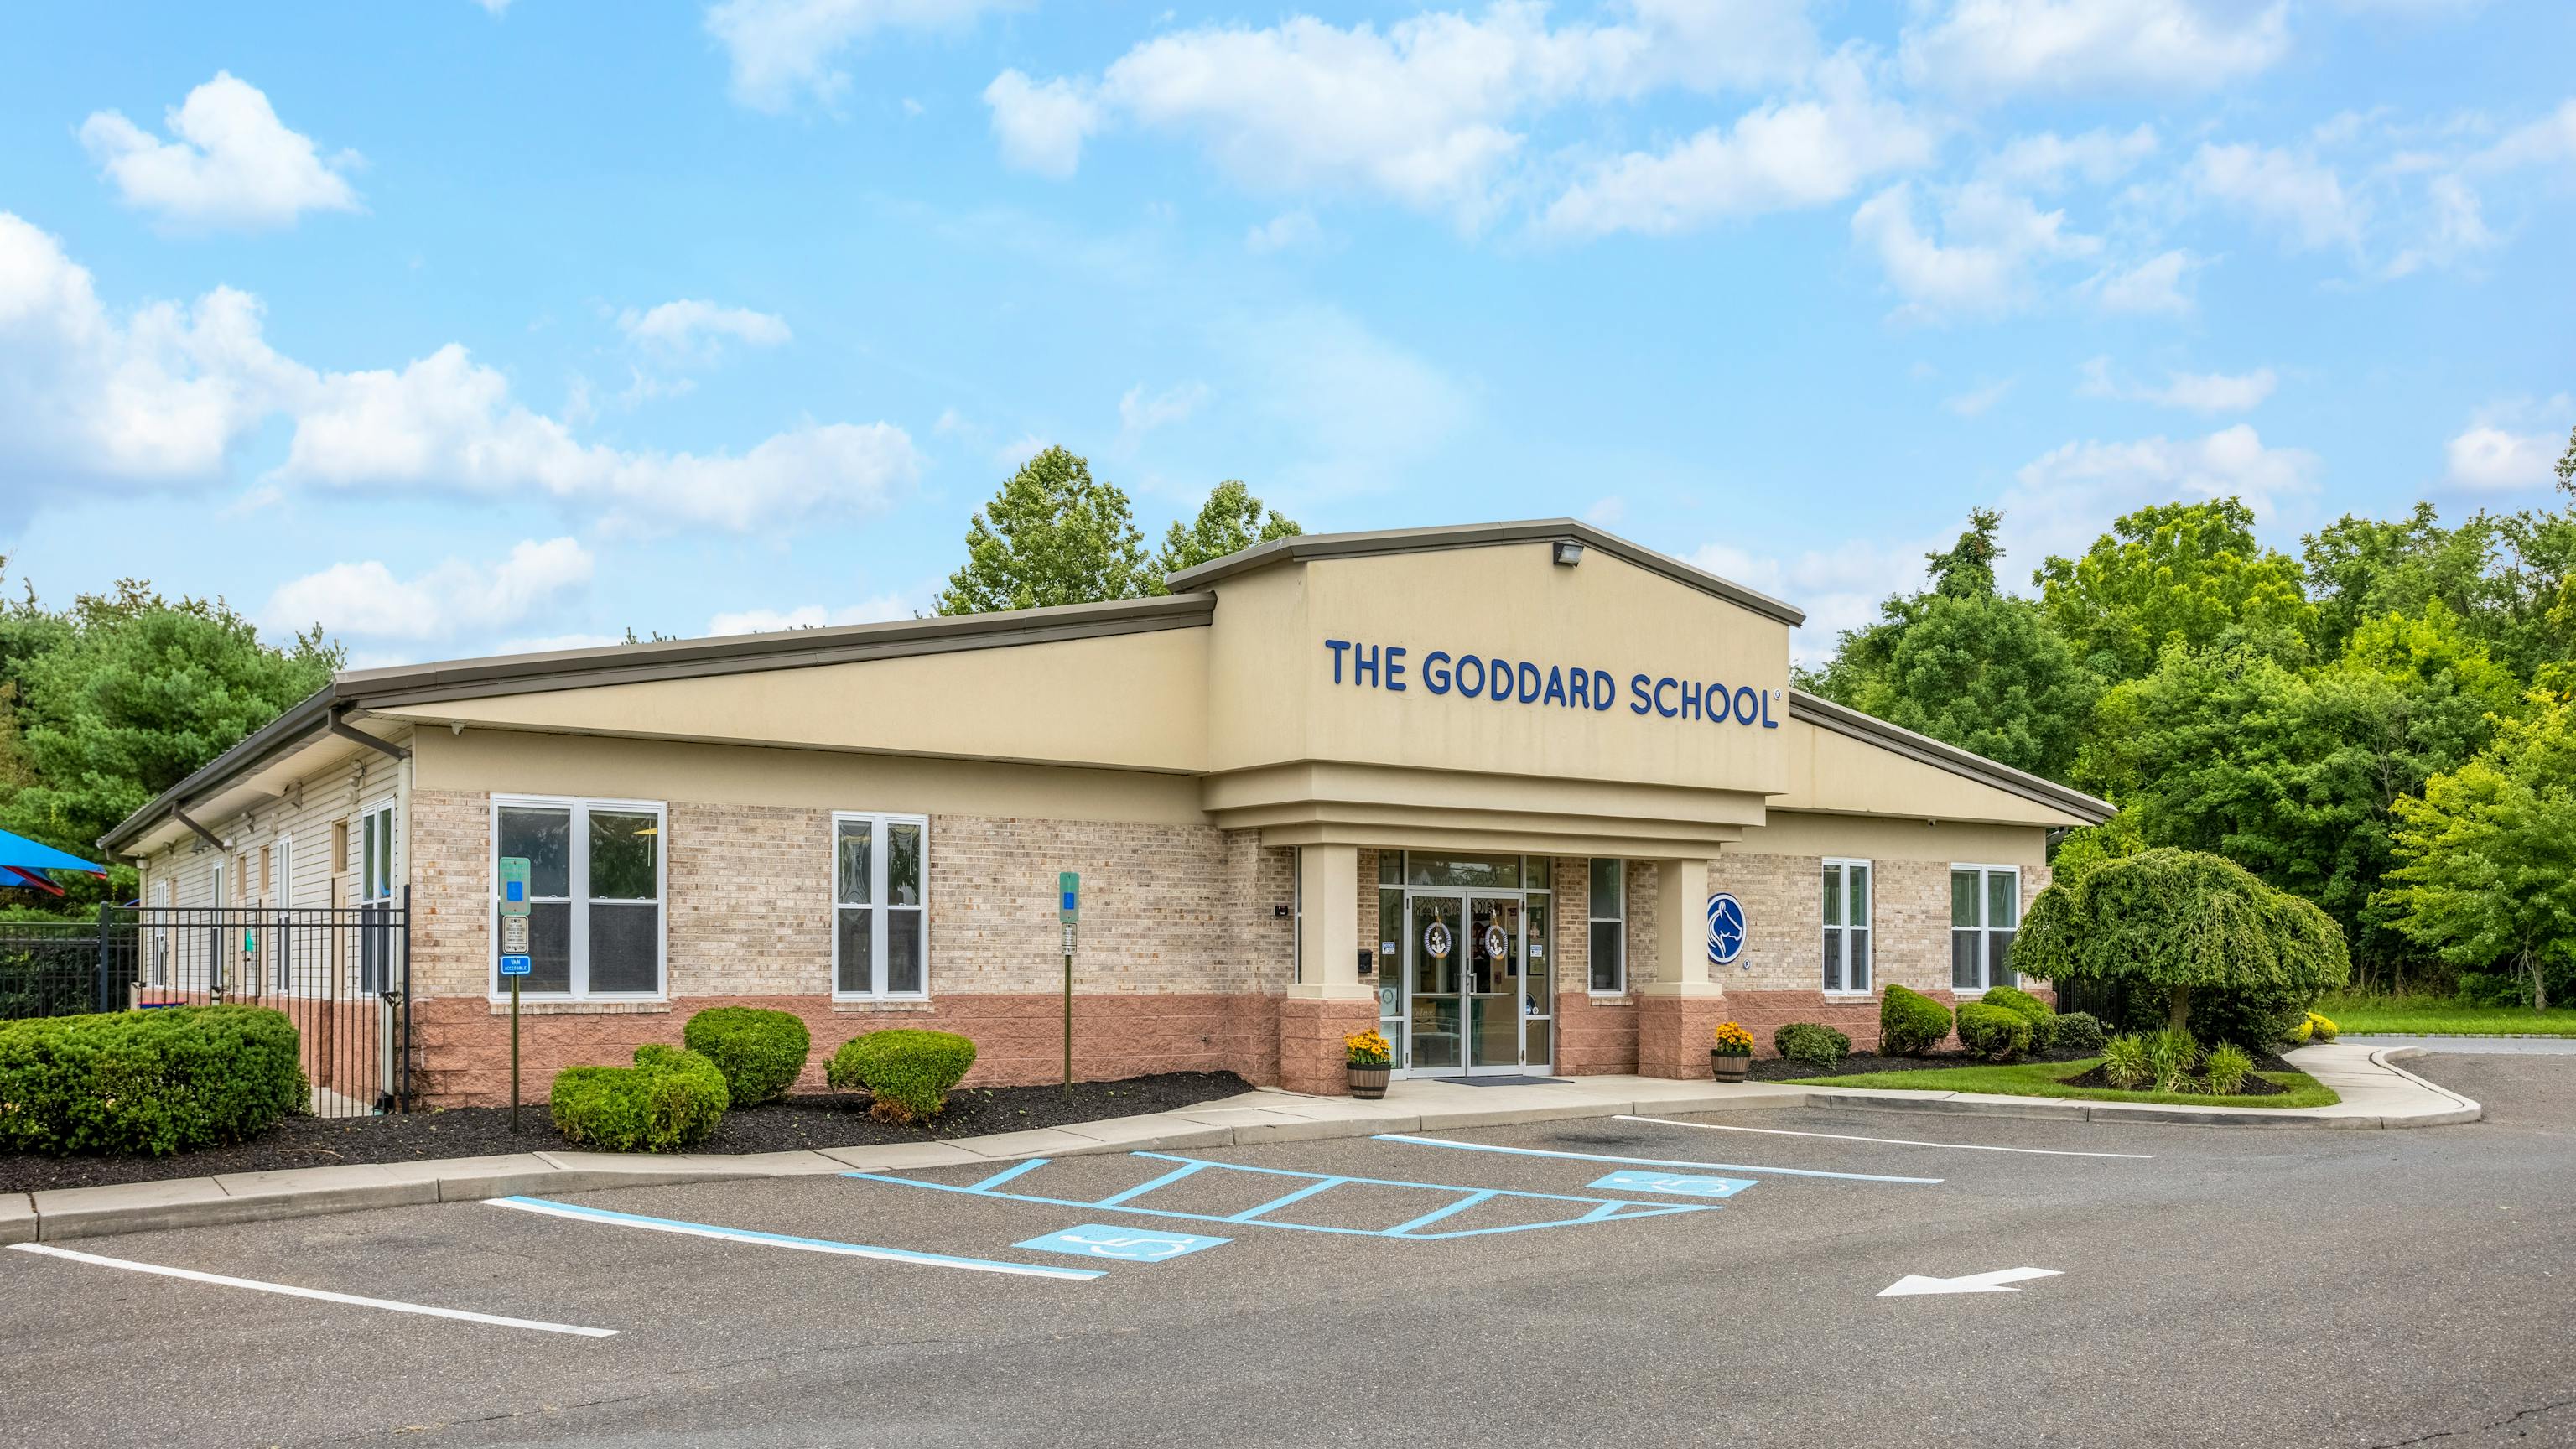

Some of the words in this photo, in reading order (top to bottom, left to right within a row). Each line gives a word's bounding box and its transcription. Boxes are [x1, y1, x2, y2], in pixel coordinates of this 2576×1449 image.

[1325, 639, 1406, 691] THE
[1422, 651, 1616, 711] GODDARD
[1630, 673, 1779, 729] SCHOOL
